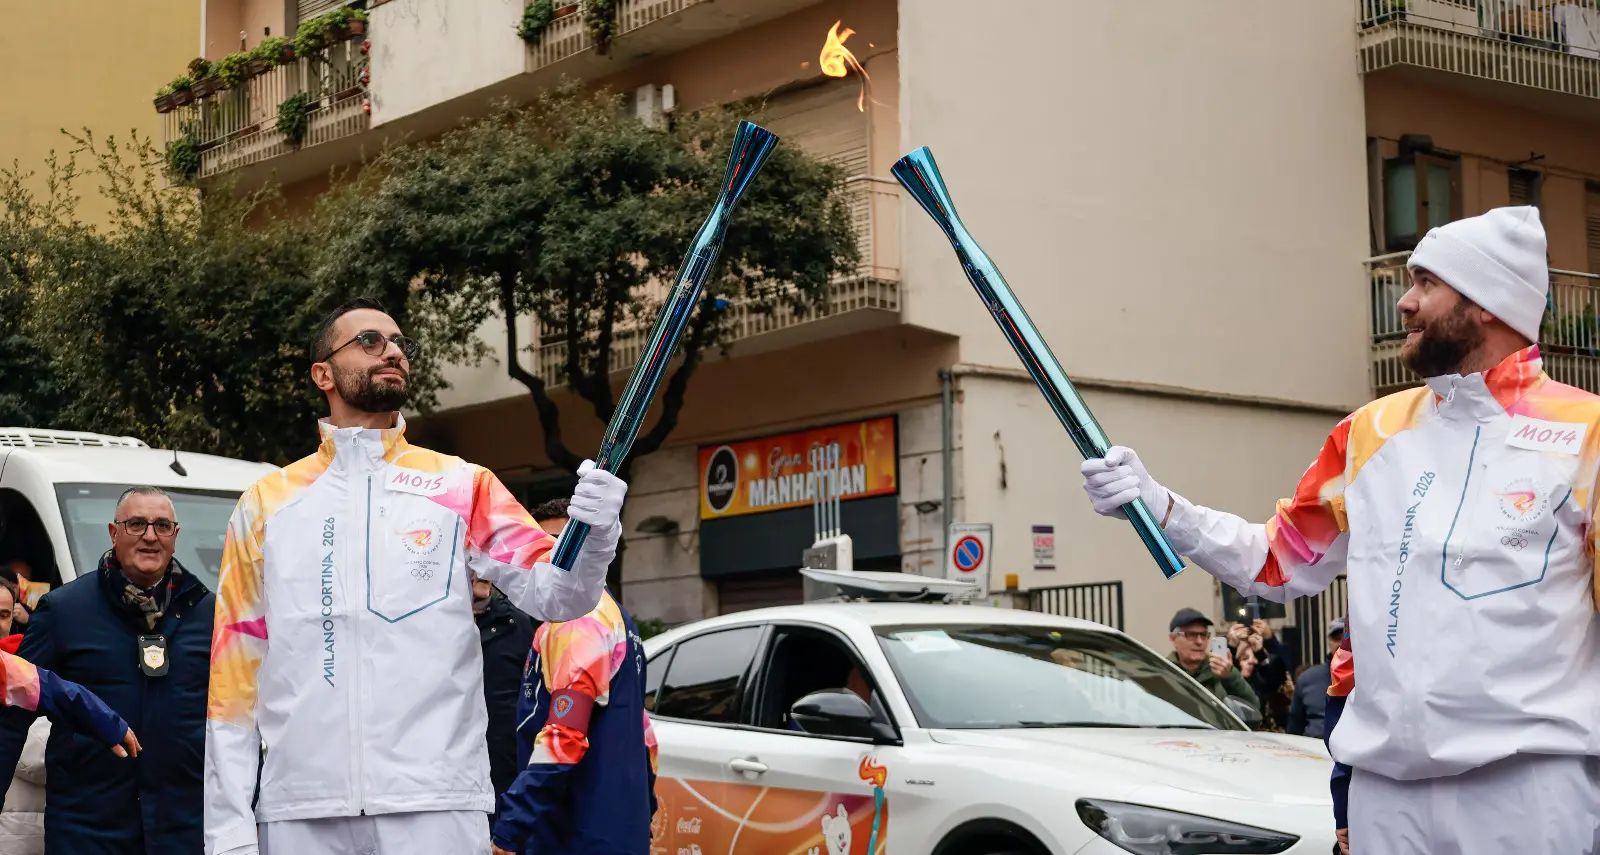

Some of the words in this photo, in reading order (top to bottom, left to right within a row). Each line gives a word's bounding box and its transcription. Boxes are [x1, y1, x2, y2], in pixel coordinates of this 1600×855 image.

[322, 516, 336, 547] 2026
[1386, 579, 1402, 658] MILANO
[1396, 501, 1421, 576] CORTINA
[1412, 470, 1436, 498] 2026
[321, 550, 333, 617] CORTINA
[323, 619, 335, 688] MILANO
